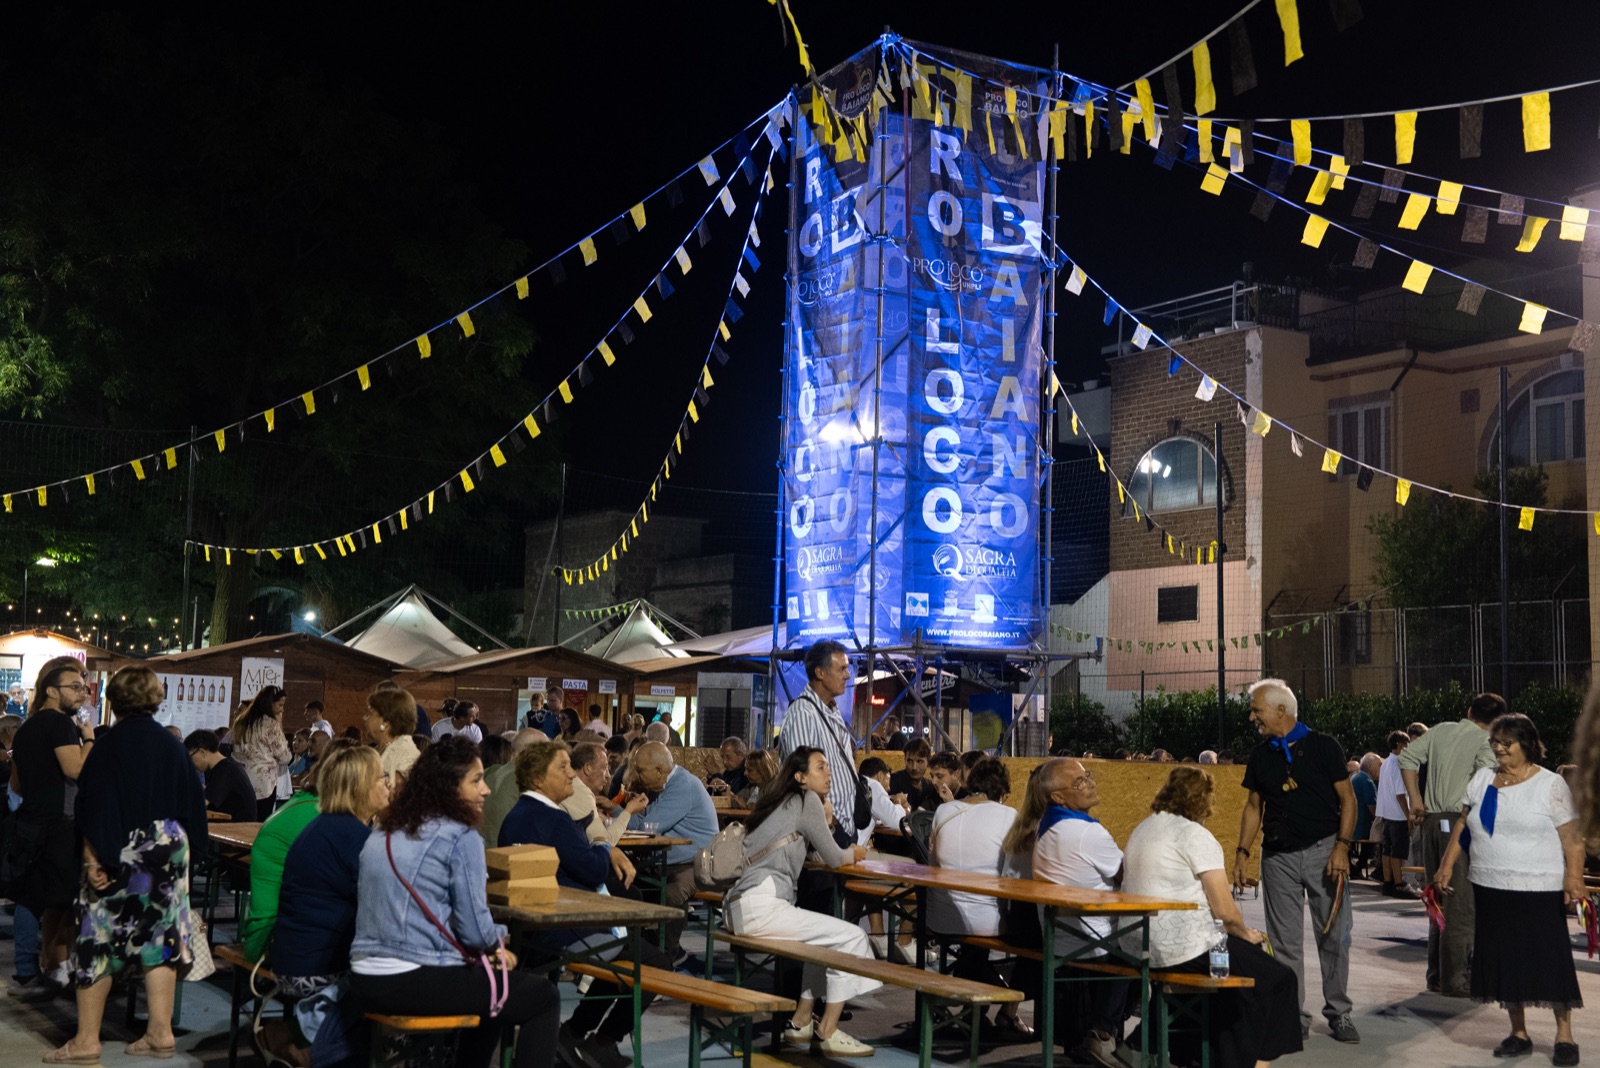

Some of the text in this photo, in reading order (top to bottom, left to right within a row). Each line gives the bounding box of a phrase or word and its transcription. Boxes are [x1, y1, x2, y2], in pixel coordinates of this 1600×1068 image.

[842, 93, 870, 112] BAIANO
[985, 92, 1002, 103] PRO
[913, 257, 984, 283] PRO LOCO
[962, 281, 982, 291] UNPLI
[812, 546, 842, 563] SAGRA
[966, 549, 1017, 566] SAGRA
[926, 629, 1020, 639] WWW.PROLOCOBAIANO.IT
[563, 680, 587, 689] PASTA
